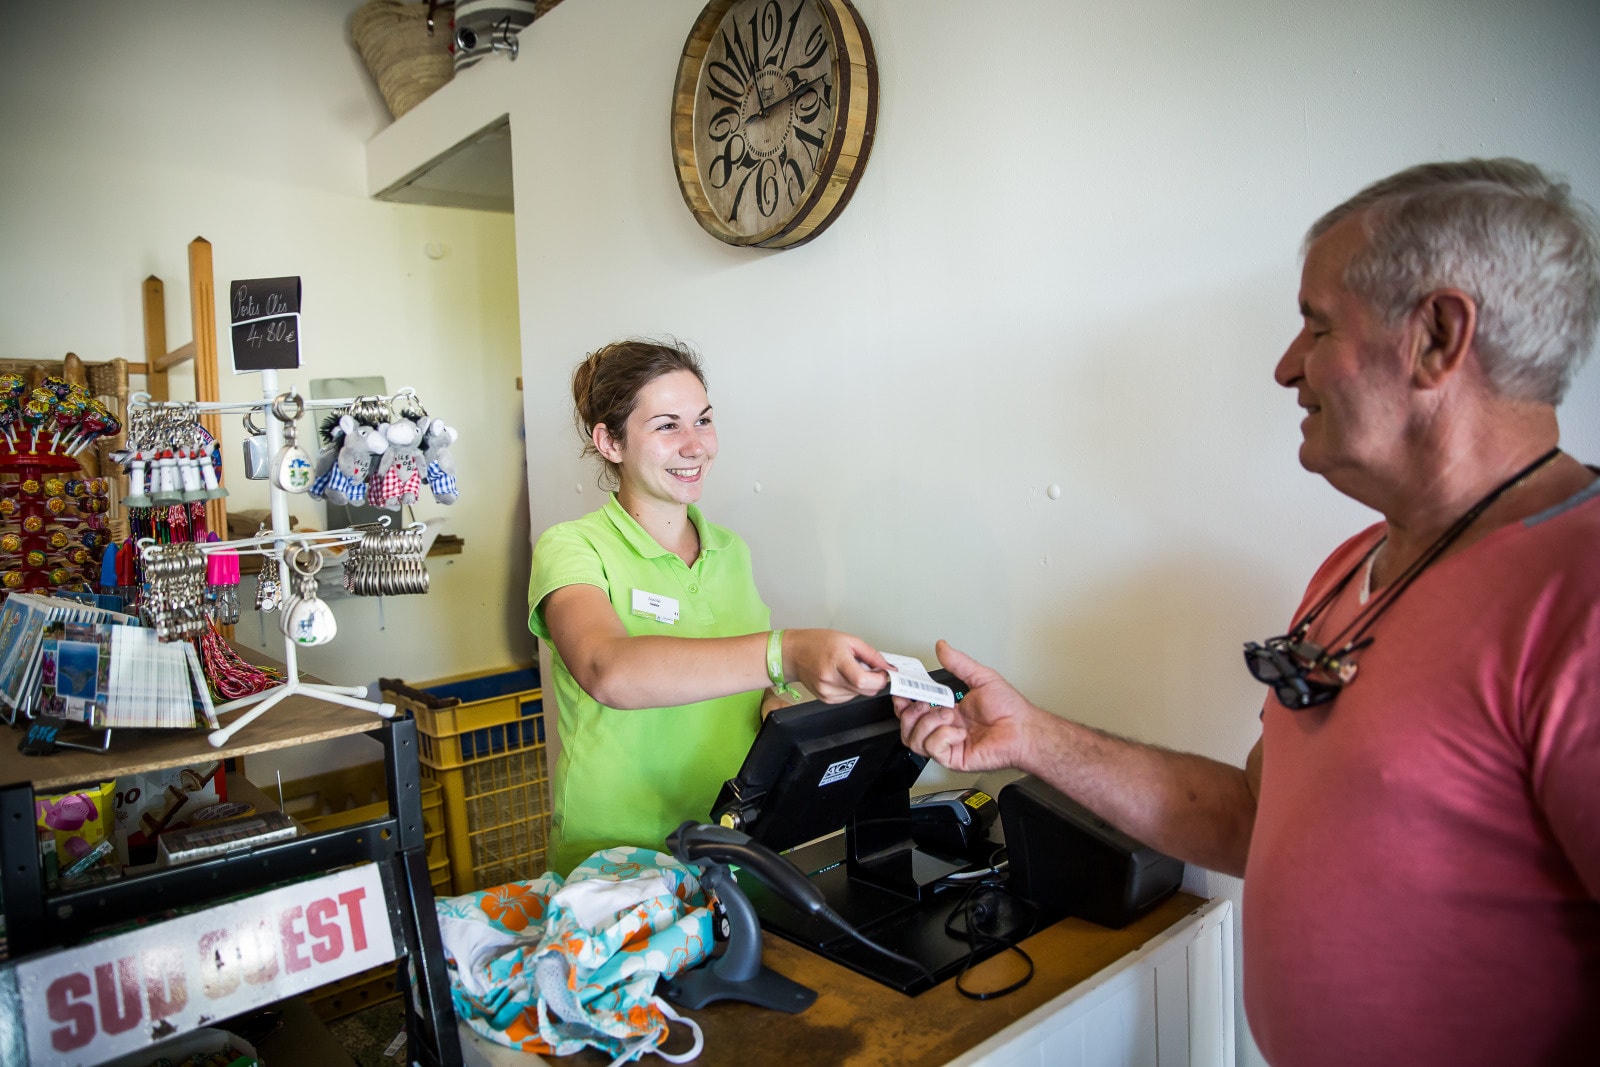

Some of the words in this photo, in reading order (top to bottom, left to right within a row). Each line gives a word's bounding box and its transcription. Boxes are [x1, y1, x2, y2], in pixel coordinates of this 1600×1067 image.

[722, 15, 757, 82] 11
[749, 0, 783, 71] 12
[779, 0, 803, 70] 1
[786, 24, 828, 87] 2
[707, 61, 745, 108] 10
[795, 75, 832, 125] 3
[708, 107, 741, 142] 9
[793, 125, 827, 171] 4
[709, 133, 746, 189] 8
[728, 150, 761, 223] 7
[755, 159, 779, 217] 6
[778, 144, 806, 206] 5
[46, 945, 189, 1053] SUD
